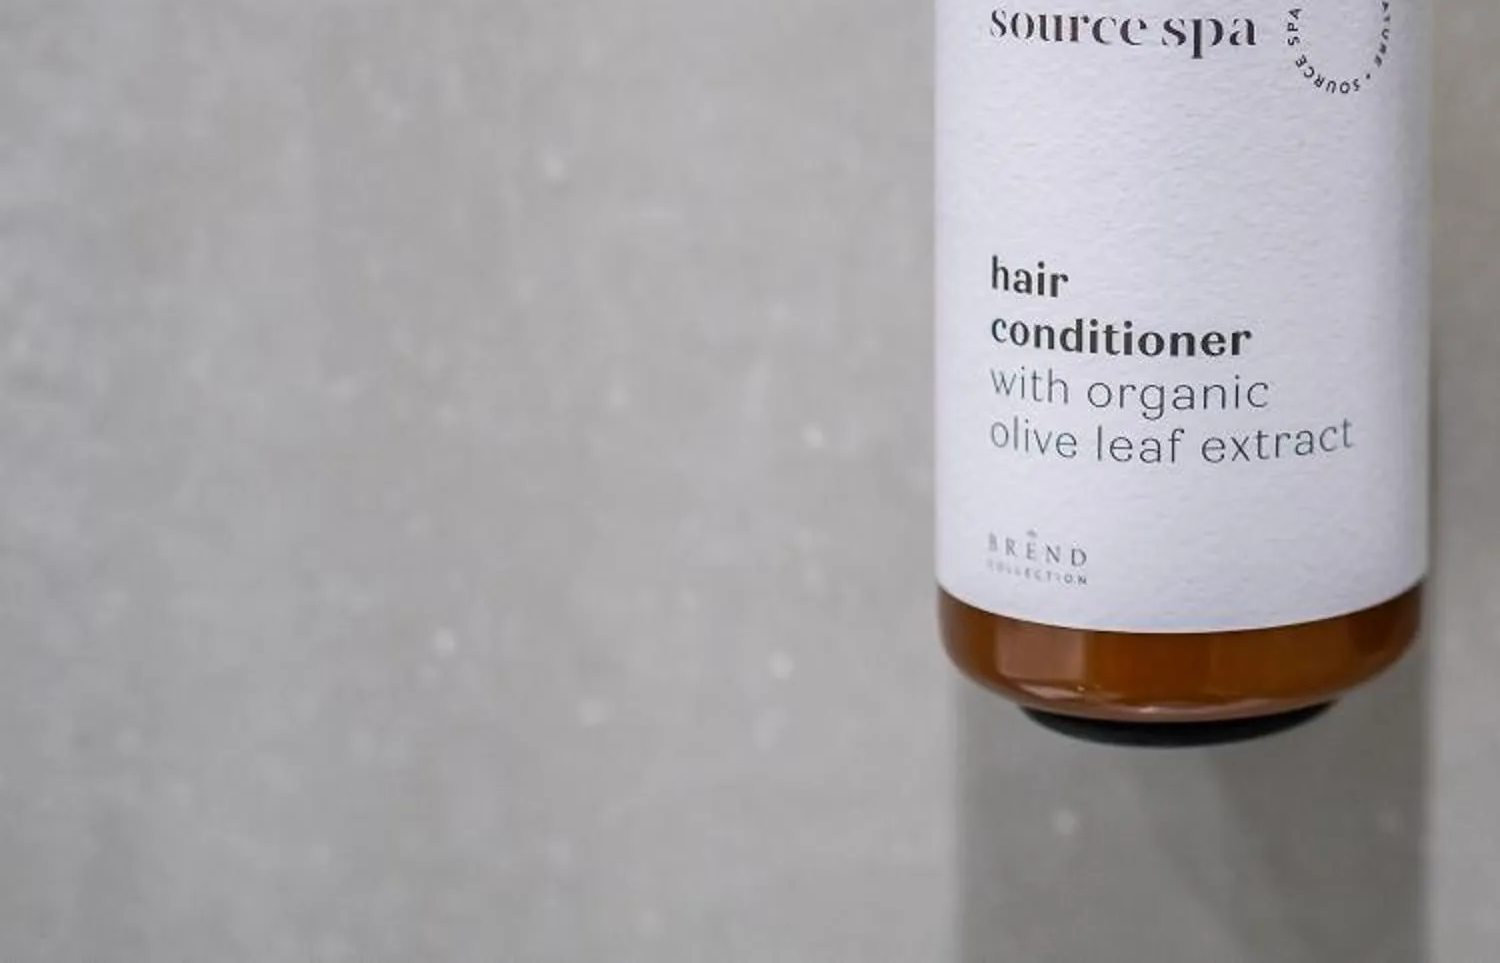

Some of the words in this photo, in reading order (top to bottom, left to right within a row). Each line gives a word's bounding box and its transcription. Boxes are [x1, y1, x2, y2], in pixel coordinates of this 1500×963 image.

[989, 6, 1148, 46] source
[1161, 17, 1257, 59] spa
[1287, 7, 1302, 46] SPA
[1295, 54, 1360, 94] SOURCE
[991, 255, 1069, 298] hair
[991, 317, 1252, 357] conditioner
[990, 366, 1070, 405] with
[1086, 374, 1270, 421] organic
[990, 416, 1079, 458] olive
[1096, 425, 1186, 464] leaf
[1201, 418, 1354, 464] extract
